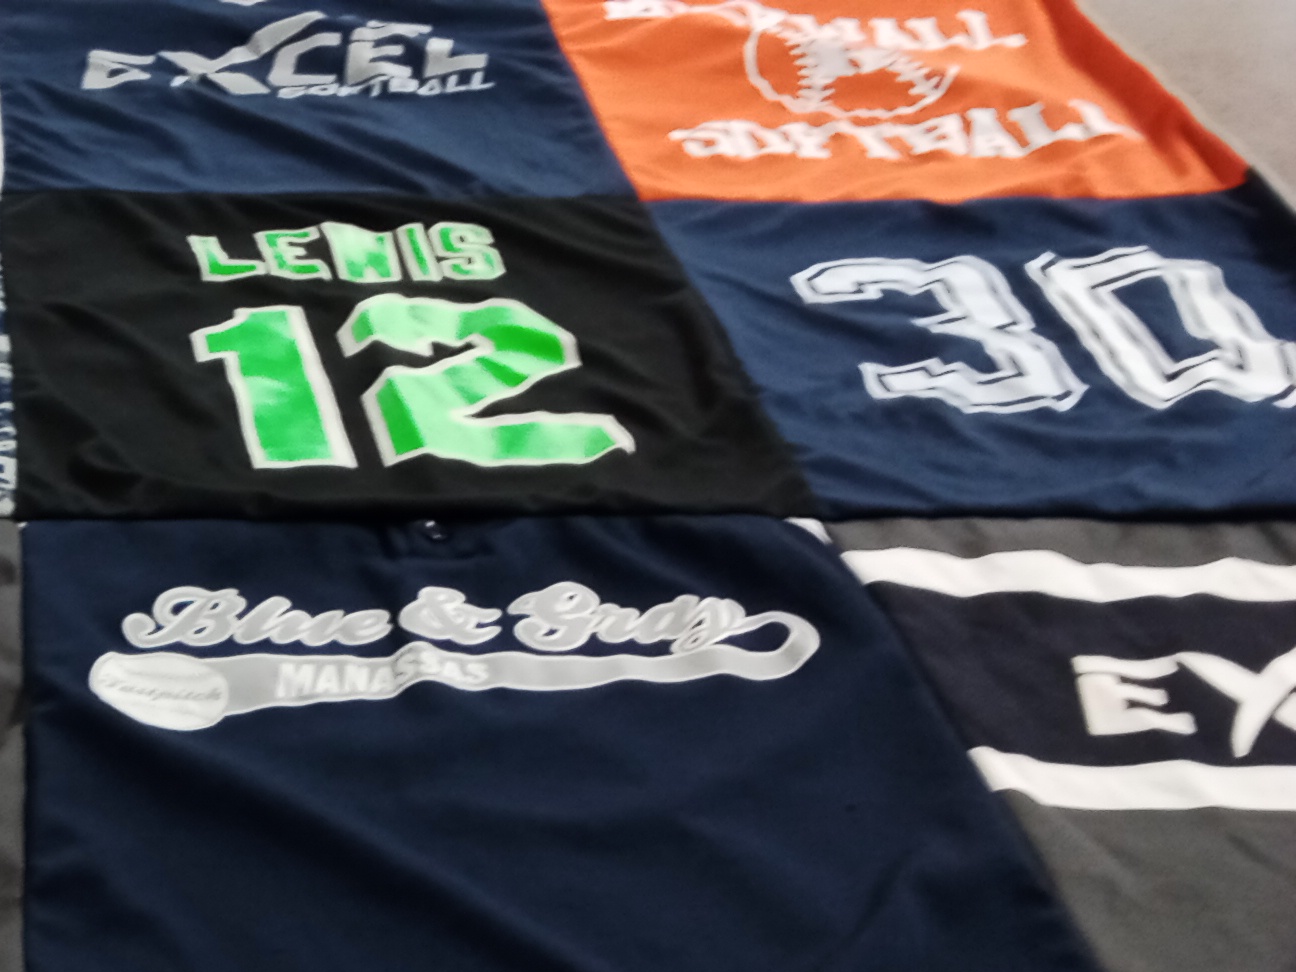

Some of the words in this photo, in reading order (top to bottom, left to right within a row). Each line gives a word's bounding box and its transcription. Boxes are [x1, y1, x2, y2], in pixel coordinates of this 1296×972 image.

[81, 11, 489, 96] EXCEL
[187, 222, 506, 282] LEWIS
[790, 245, 1296, 415] 30
[189, 294, 636, 469] 12
[122, 586, 394, 648] Blue
[399, 586, 502, 643] &
[507, 581, 756, 656] Gray
[275, 652, 489, 698] MANASSAS
